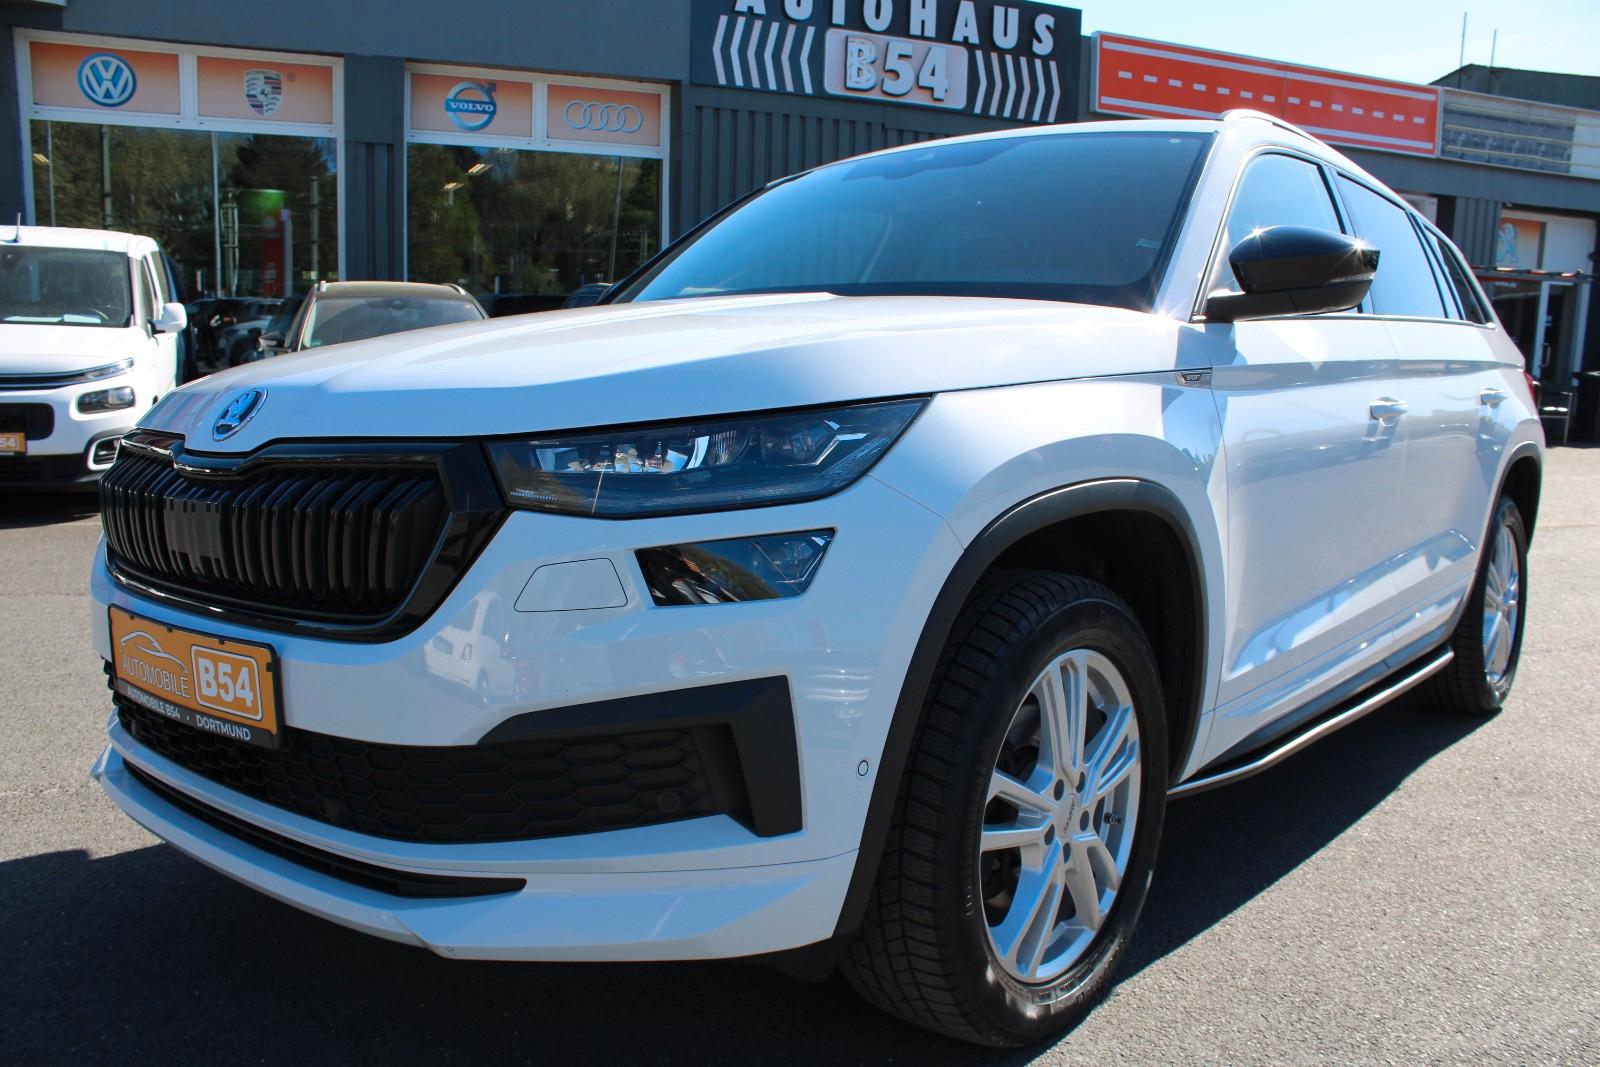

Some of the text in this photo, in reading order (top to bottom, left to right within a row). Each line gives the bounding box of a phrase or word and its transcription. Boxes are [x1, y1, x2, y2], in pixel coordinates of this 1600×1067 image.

[844, 35, 950, 102] B54
[449, 101, 494, 112] VOLVO
[122, 656, 191, 699] AUTOMOBILE
[198, 656, 254, 708] B54
[127, 687, 251, 741] AUTOMOBILE B54 DORTMUND
